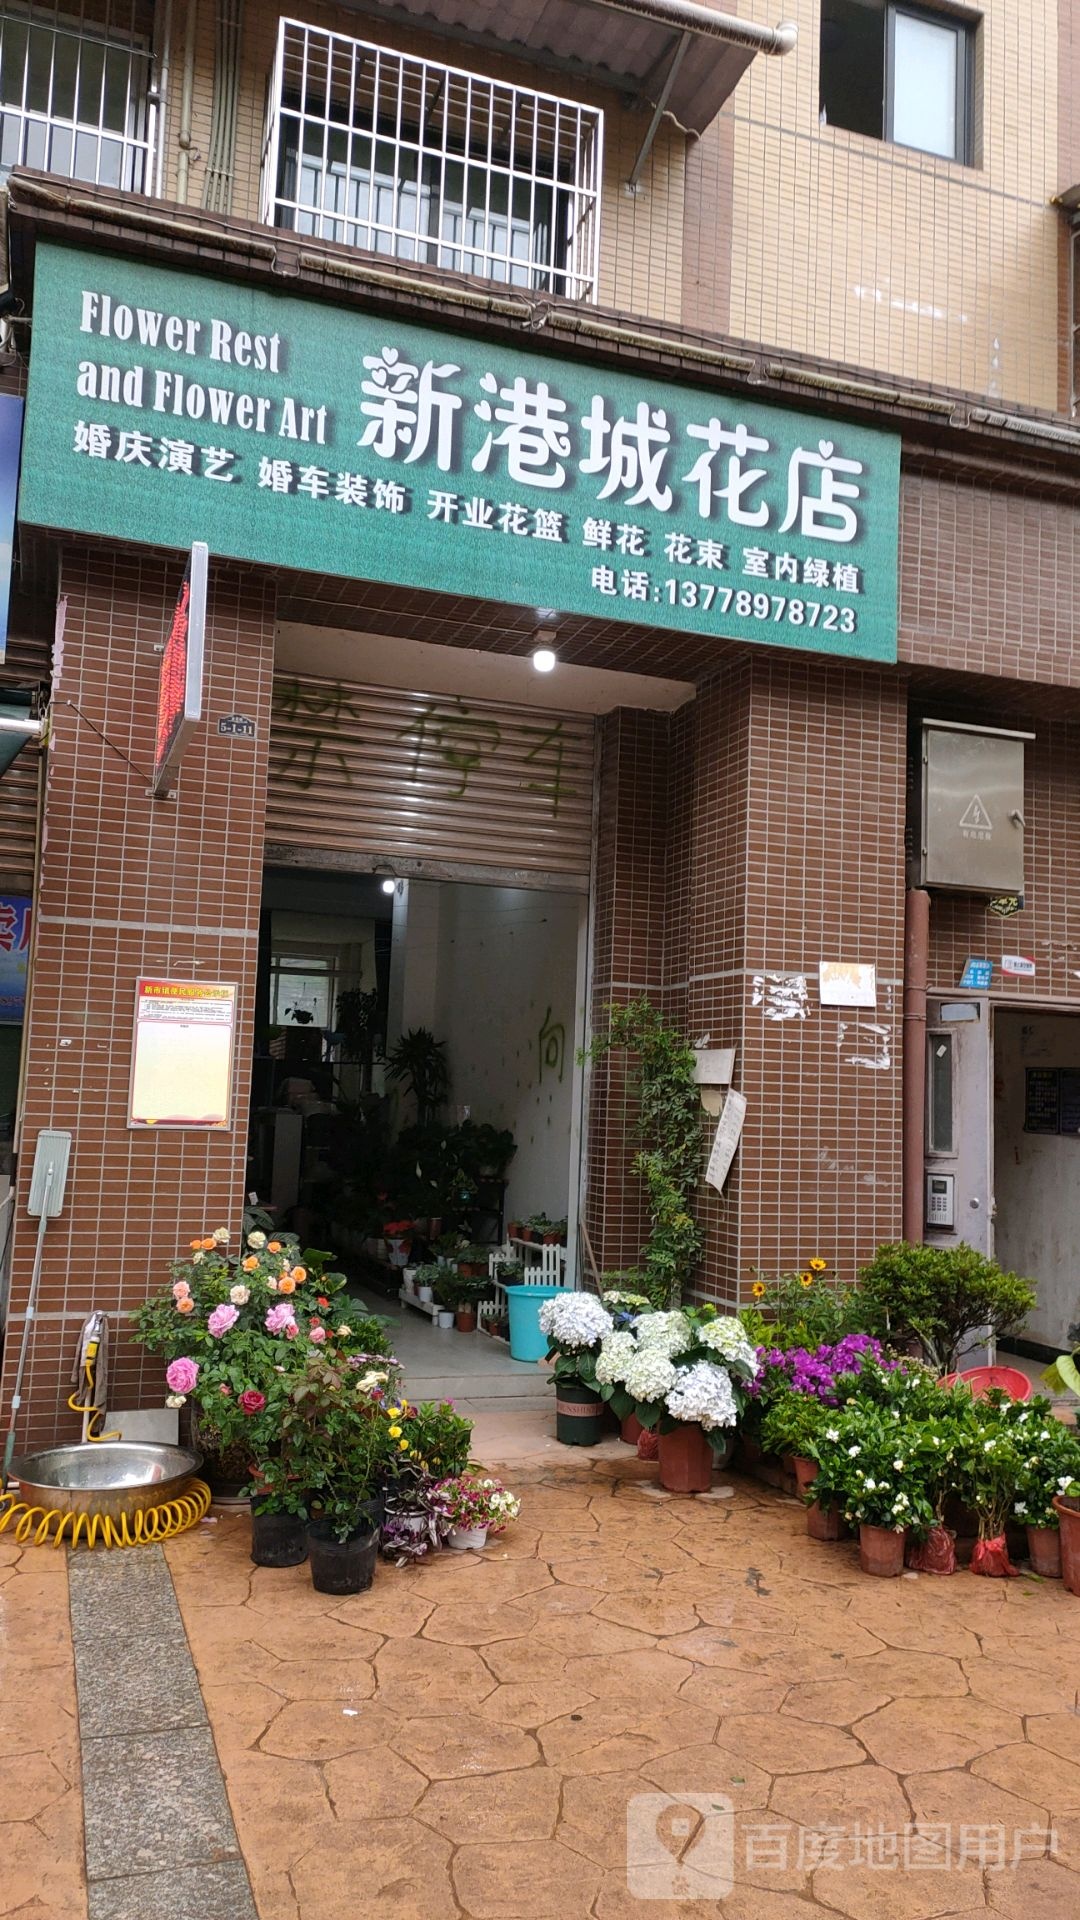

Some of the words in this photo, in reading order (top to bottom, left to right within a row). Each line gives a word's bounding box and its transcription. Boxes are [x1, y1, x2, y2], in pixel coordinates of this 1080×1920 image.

[79, 289, 201, 356] Flower
[208, 318, 281, 374] Rest
[76, 360, 144, 408] and
[152, 369, 271, 434] Flower
[278, 396, 328, 446] Art
[358, 346, 864, 543] 新港城花店
[72, 418, 236, 483] 婚庆演艺
[257, 455, 407, 514] 婚车装饰
[426, 489, 564, 543] 开业花篮
[581, 516, 645, 557] 鲜花
[663, 531, 724, 571] 花束
[741, 545, 860, 594] 室内绿植
[591, 564, 856, 634] 电话:13778978723
